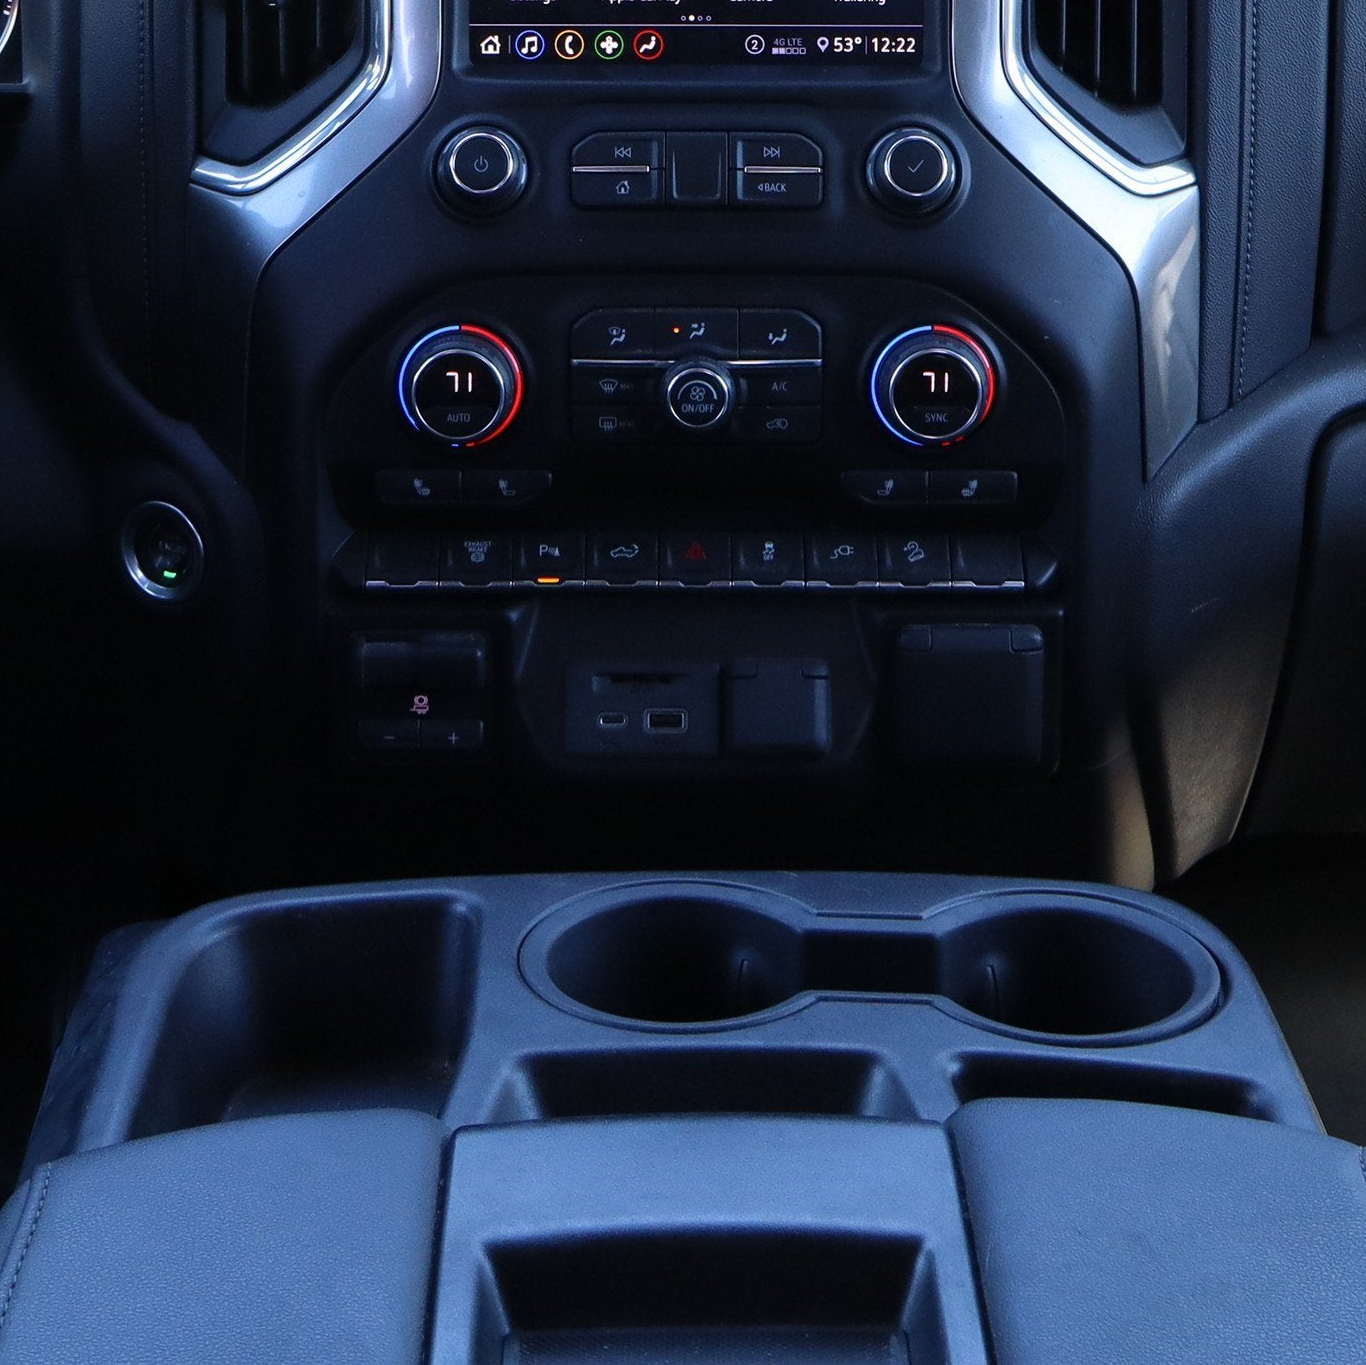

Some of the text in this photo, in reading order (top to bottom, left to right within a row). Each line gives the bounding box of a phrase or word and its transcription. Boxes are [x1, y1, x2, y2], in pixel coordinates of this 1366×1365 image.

[772, 37, 804, 47] 4G LTE
[833, 36, 862, 53] 53°
[871, 37, 916, 53] 12:22
[764, 182, 787, 193] BACK
[445, 371, 473, 393] 71
[771, 381, 788, 392] A/C
[922, 371, 949, 393] 71
[681, 403, 716, 414] ON/OFF
[446, 412, 471, 423] AUTO
[924, 412, 948, 423] SYNC
[464, 540, 492, 548] EXHAUST
[762, 552, 775, 561] OFF
